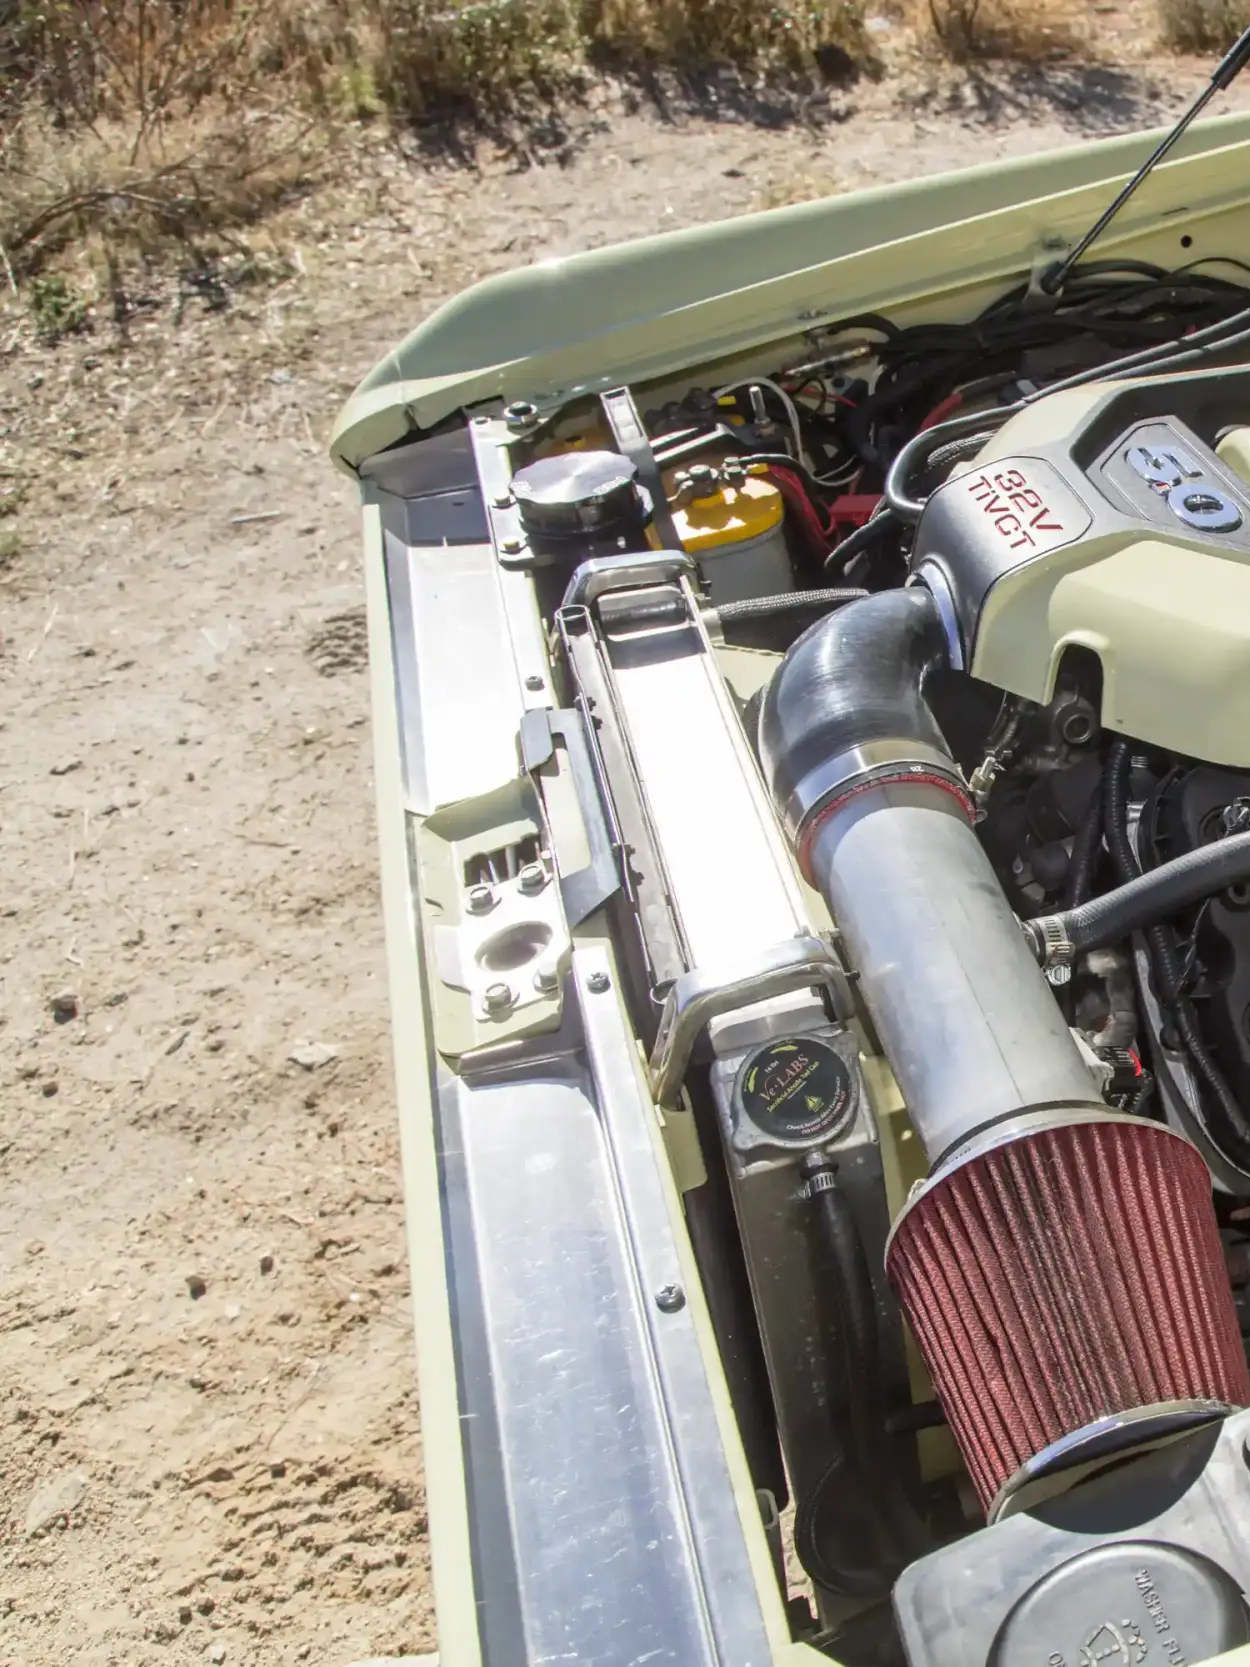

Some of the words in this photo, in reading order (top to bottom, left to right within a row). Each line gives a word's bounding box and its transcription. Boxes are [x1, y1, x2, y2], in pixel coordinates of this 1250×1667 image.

[968, 475, 1036, 549] TiVCT
[994, 469, 1064, 531] 32V
[1124, 446, 1244, 533] 5.0
[1135, 1569, 1171, 1634] WASHER
